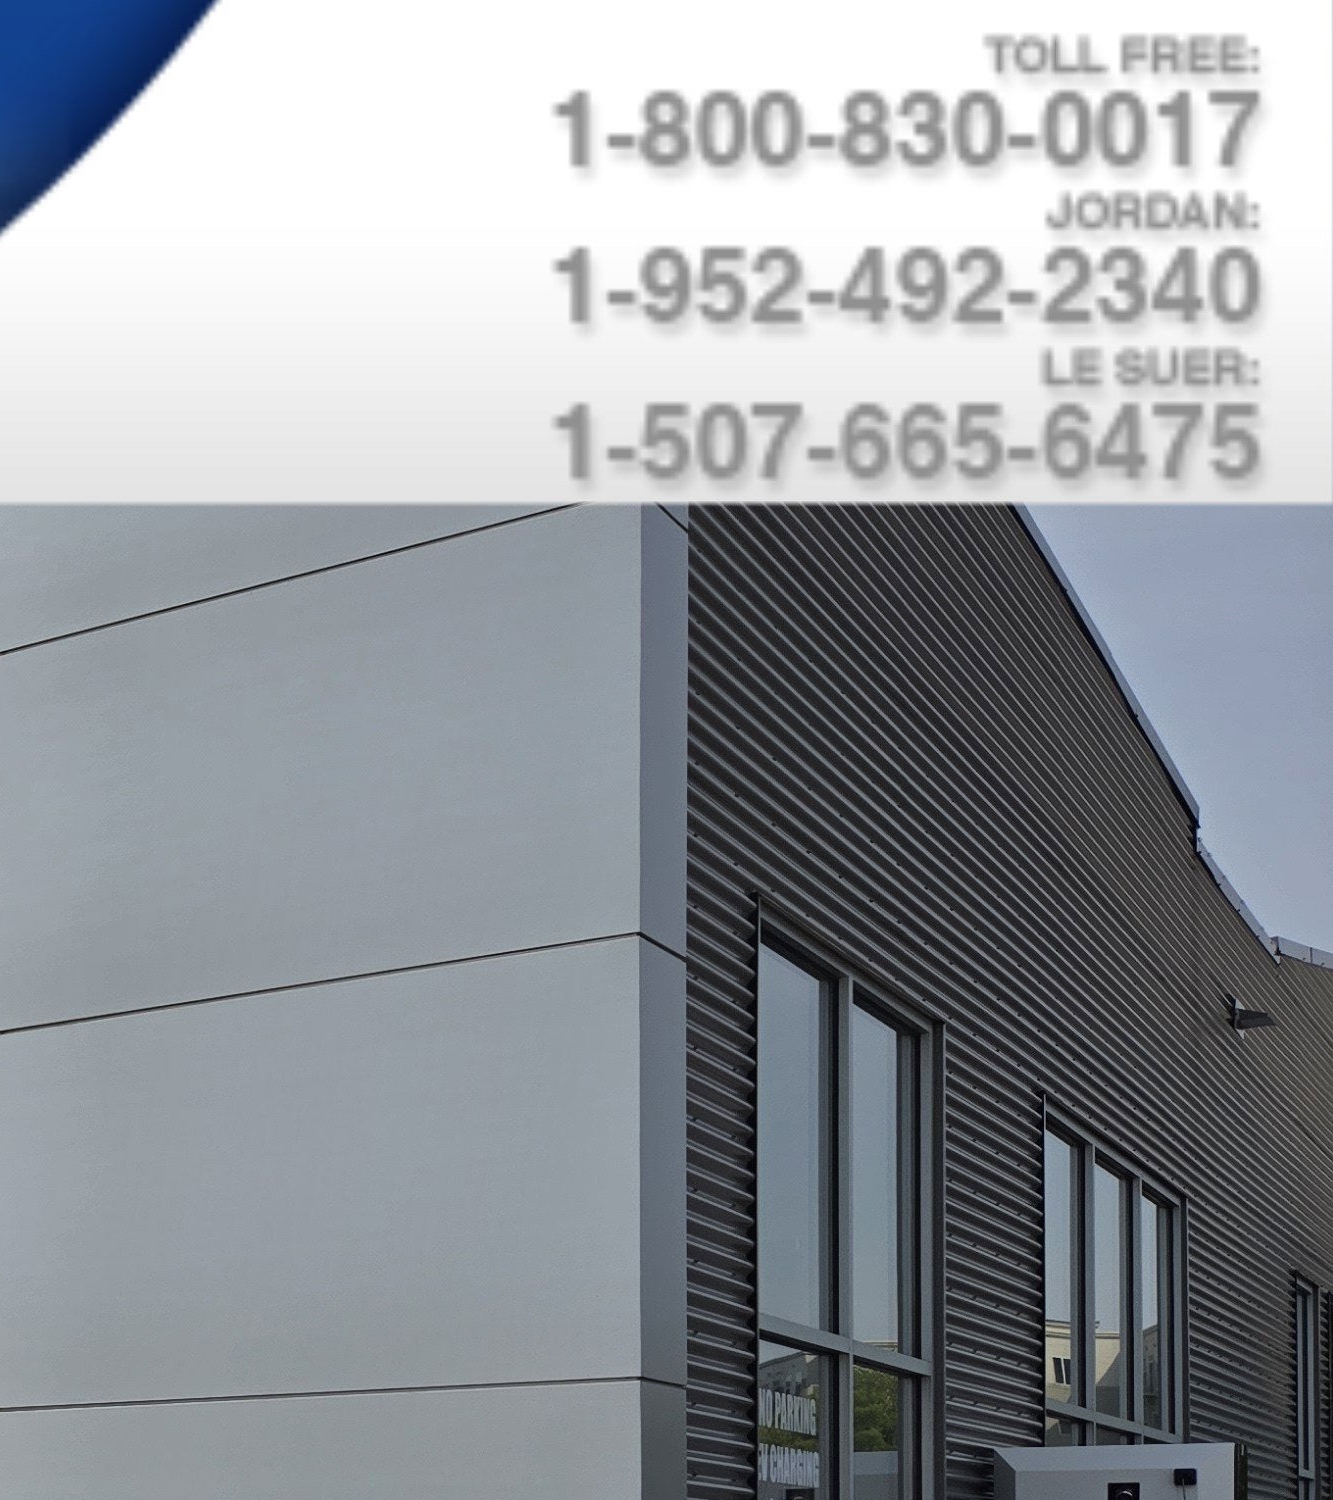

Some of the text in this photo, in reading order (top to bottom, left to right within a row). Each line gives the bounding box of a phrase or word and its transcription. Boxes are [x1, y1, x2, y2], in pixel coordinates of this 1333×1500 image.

[758, 1387, 817, 1436] NO PARKING
[771, 1444, 820, 1488] CHARGING
